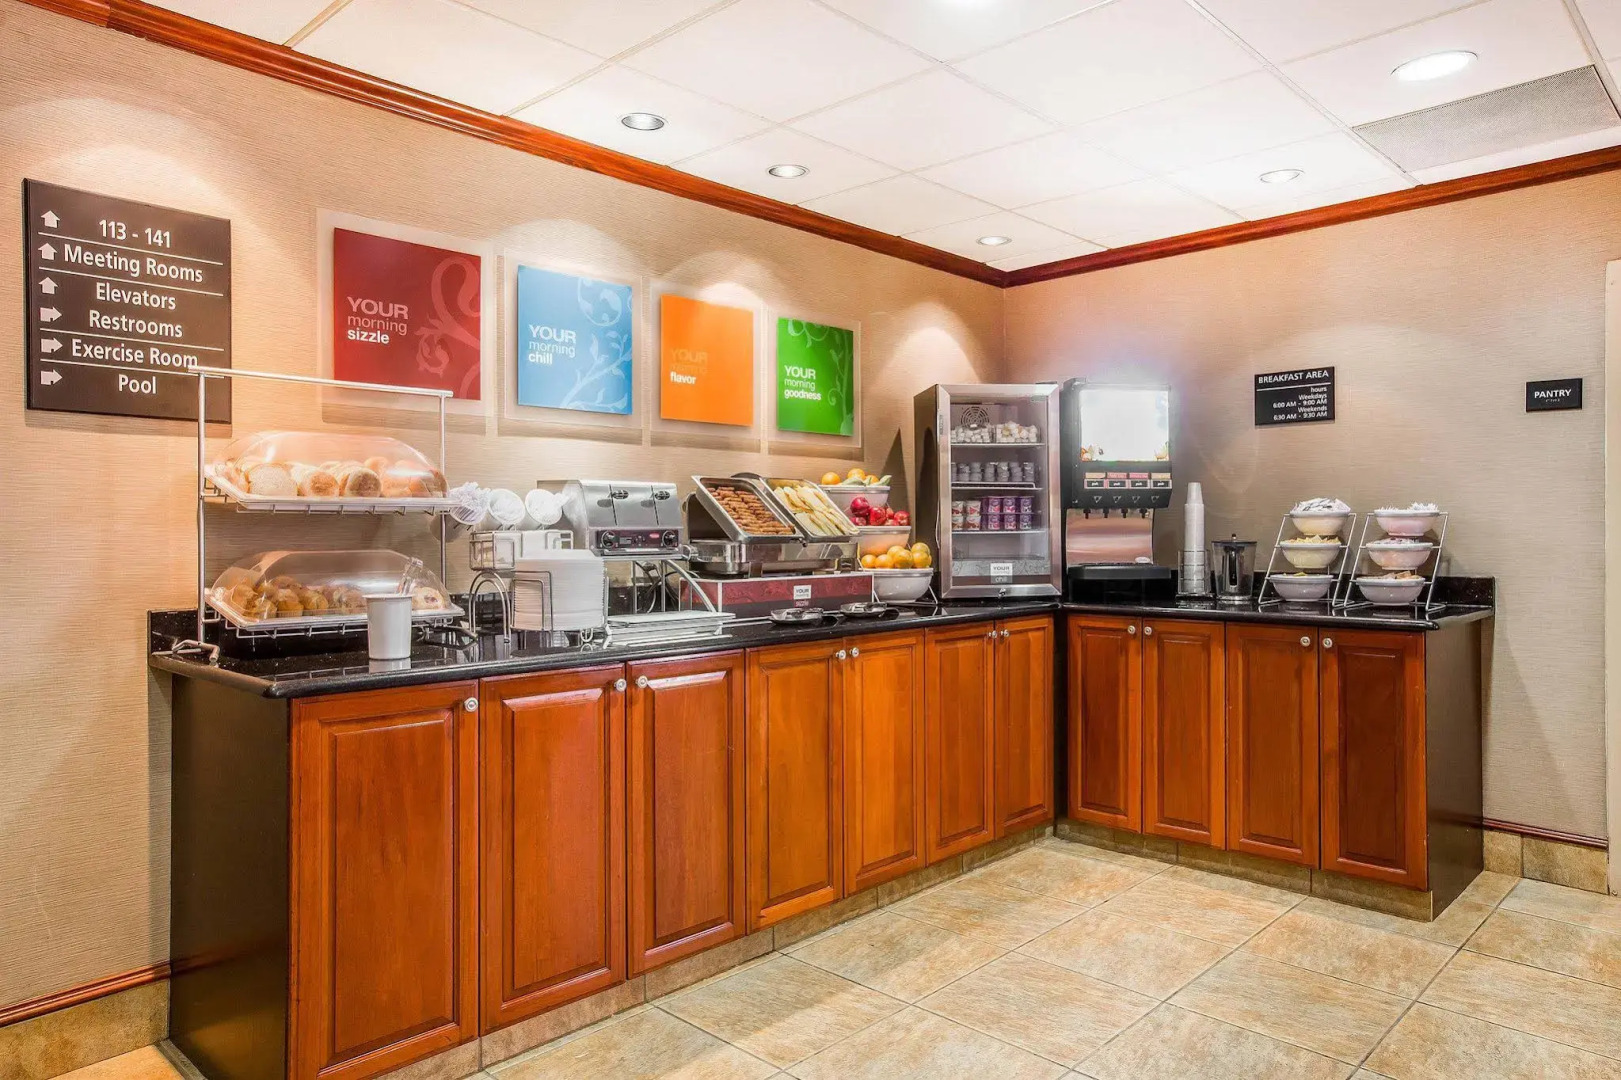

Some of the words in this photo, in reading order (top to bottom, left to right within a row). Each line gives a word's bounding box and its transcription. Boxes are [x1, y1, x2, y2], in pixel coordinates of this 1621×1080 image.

[99, 219, 127, 240] 113
[144, 227, 171, 248] 141
[64, 243, 140, 277] Meeting
[146, 257, 203, 283] Rooms
[96, 282, 177, 310] Elevators
[347, 296, 409, 320] YOUR
[89, 309, 183, 338] Restrooms
[347, 315, 408, 336] morning
[347, 327, 390, 344] sizzle
[528, 324, 577, 344] YOUR
[71, 338, 144, 364] Exercise
[150, 347, 198, 368] Room
[528, 341, 576, 359] morning
[528, 351, 553, 365] chill
[671, 347, 708, 365] YOUR
[670, 370, 697, 385] flavor
[784, 364, 816, 380] YOUR
[1258, 372, 1304, 384] BREAKFAST
[1305, 370, 1329, 380] AREA
[118, 373, 157, 395] Pool
[784, 378, 816, 392] morning
[784, 389, 822, 400] goodness
[1298, 393, 1327, 401] Weekdays
[1534, 388, 1572, 399] PANTRY
[1298, 405, 1328, 413] Weekends
